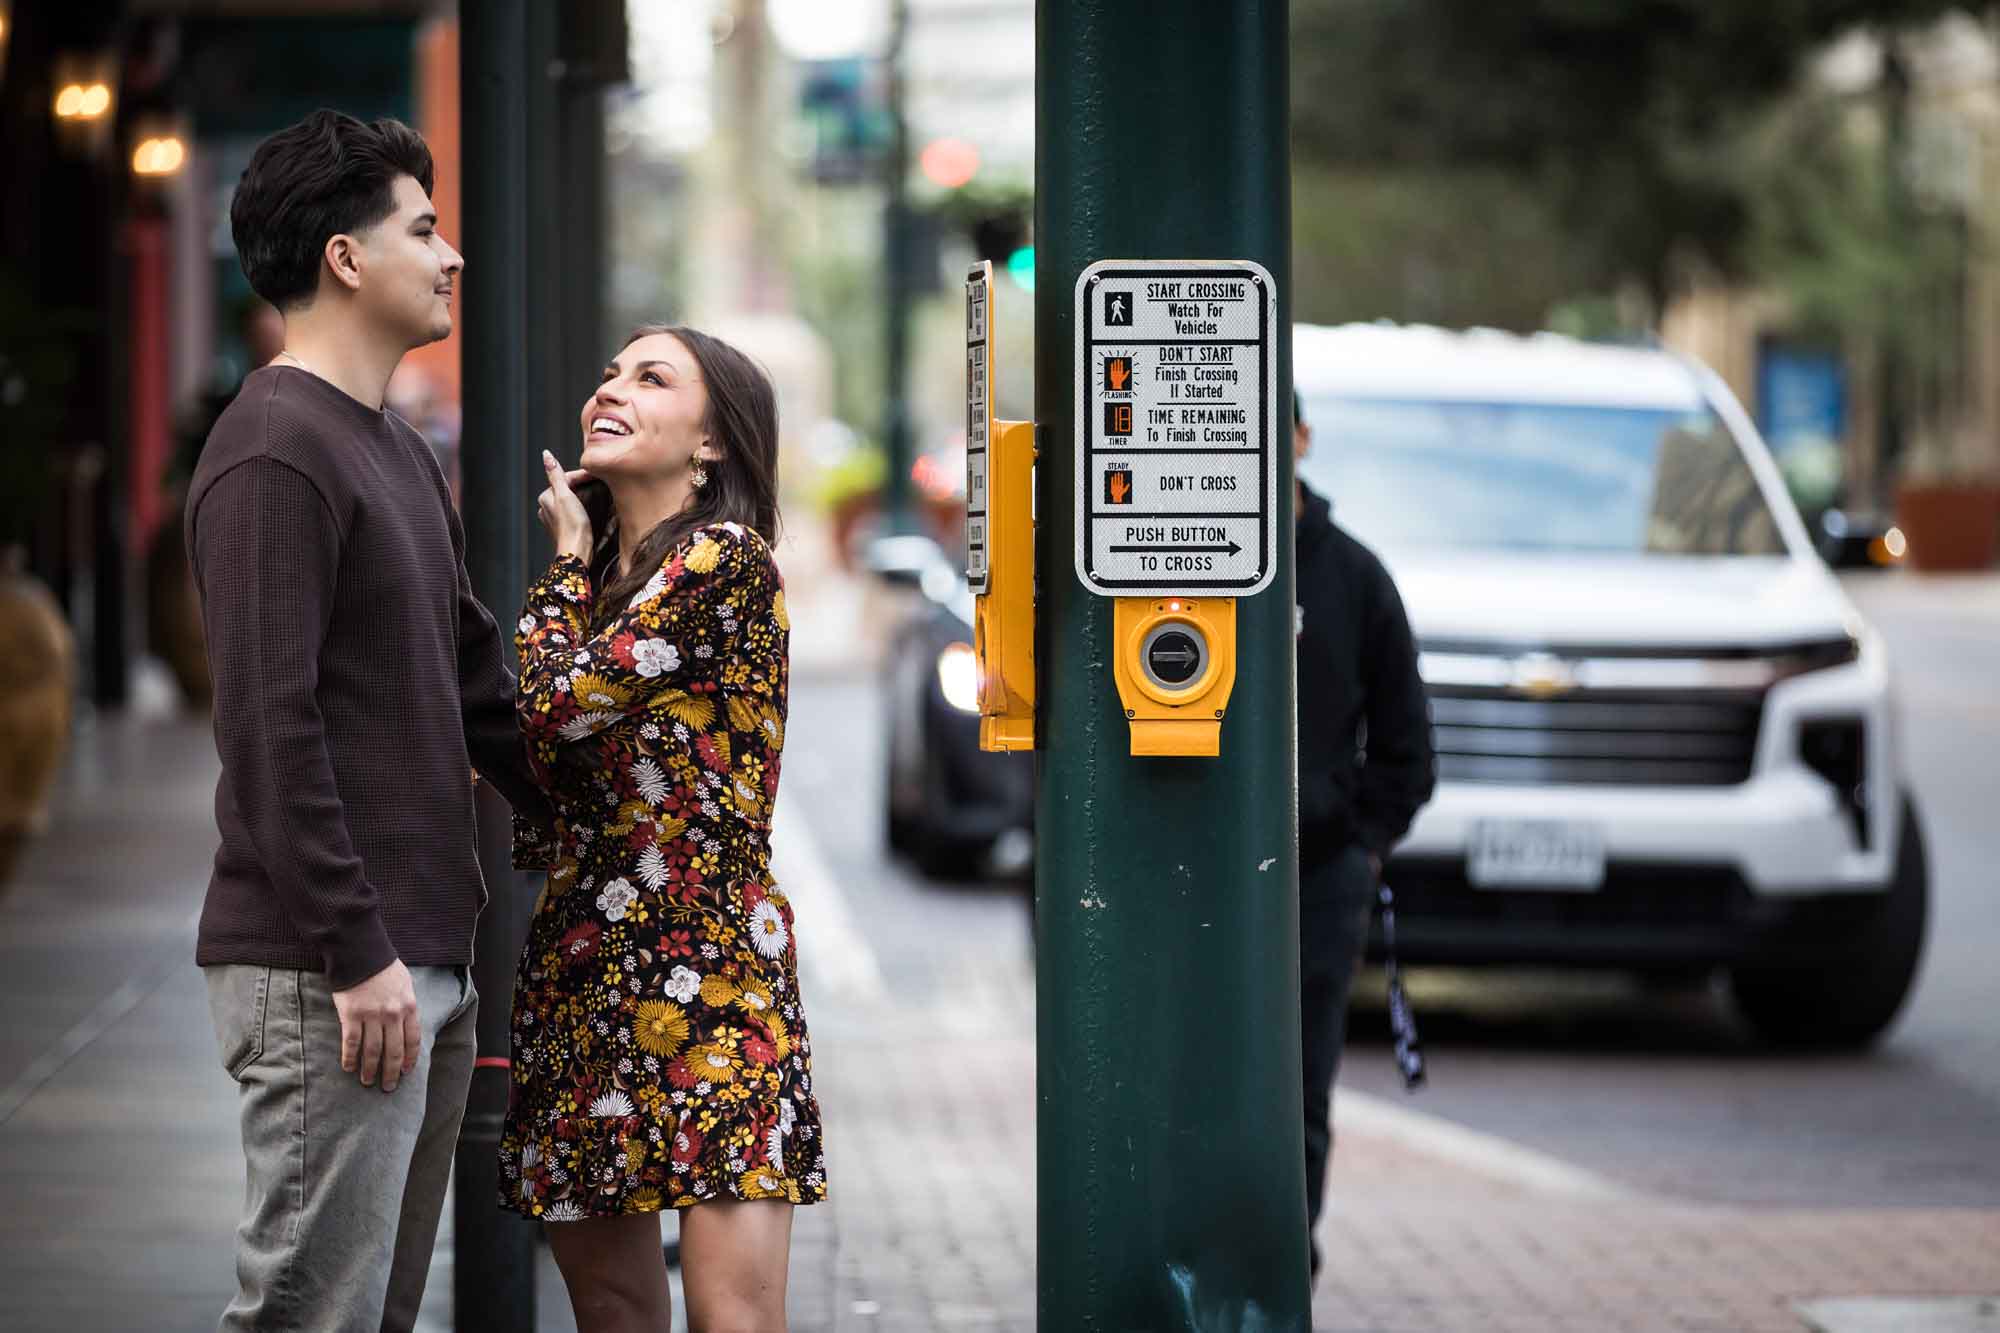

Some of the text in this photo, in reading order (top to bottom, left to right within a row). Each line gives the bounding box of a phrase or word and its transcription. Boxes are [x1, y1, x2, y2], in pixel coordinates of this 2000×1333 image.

[1147, 284, 1244, 297] START CROSSING
[1168, 303, 1223, 317] Watch For
[1174, 320, 1217, 334] Vehicles
[1159, 347, 1233, 361] DON'T START
[1155, 367, 1238, 384] Finish Crossing
[1104, 391, 1132, 399] FLASHING
[1185, 384, 1223, 398] Started
[1148, 410, 1246, 423] TIME REMAINING
[1109, 437, 1127, 445] TIMER
[1147, 428, 1247, 446] To Finish Crossing
[1108, 462, 1128, 470] STEADY
[1160, 476, 1237, 490] DON'T CROSS
[1126, 527, 1226, 541] PUSH BUTTON
[1140, 556, 1212, 571] TO CROSS
